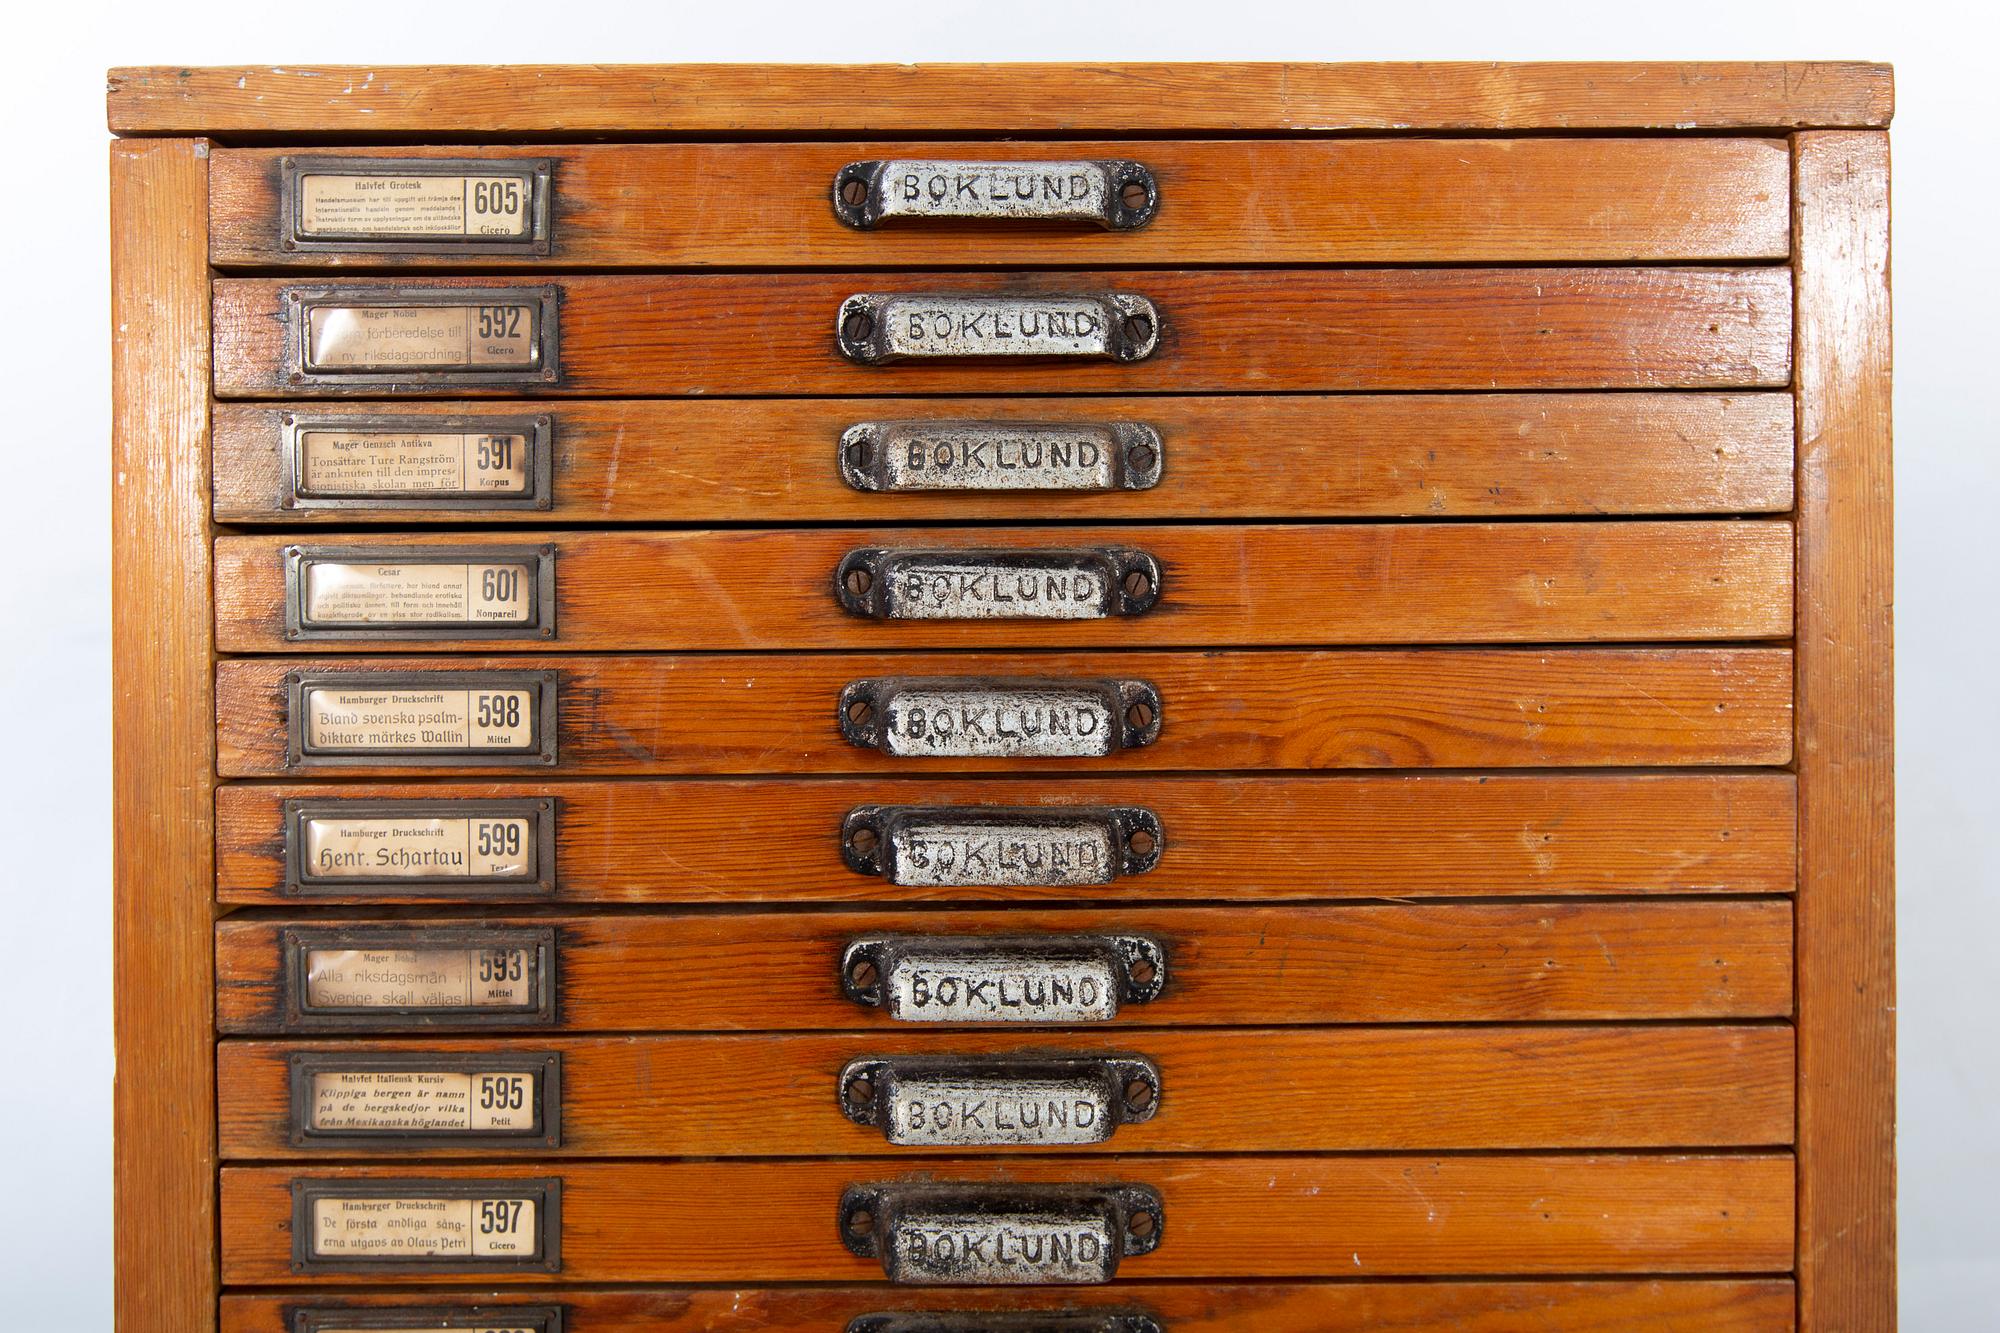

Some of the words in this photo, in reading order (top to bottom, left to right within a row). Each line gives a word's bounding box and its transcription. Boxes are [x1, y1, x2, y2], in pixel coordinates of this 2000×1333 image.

[355, 181, 386, 190] Halvfet
[390, 181, 422, 190] Grotesk
[903, 174, 1091, 204] BOKLUND
[474, 181, 518, 215] 605
[480, 225, 510, 235] Cicero
[361, 310, 388, 319] Mager
[393, 309, 417, 318] Nobel
[479, 307, 521, 339] 592
[908, 312, 1098, 341] BOKLUND
[367, 327, 444, 340] förberedelse
[448, 326, 462, 337] till
[342, 352, 355, 362] ny
[365, 349, 462, 363] riksdagsordning
[487, 346, 514, 355] Cicero
[332, 441, 358, 451] Mager
[363, 440, 397, 449] Genzsch
[400, 439, 433, 448] Antikva
[311, 456, 366, 468] Tonsättare
[369, 455, 395, 465] Ture
[399, 454, 455, 466] Rangström
[477, 437, 512, 471] 591
[907, 441, 1099, 470] BOKLUND
[311, 470, 321, 479] är
[325, 468, 373, 478] anknuten
[376, 467, 391, 477] till
[394, 467, 414, 477] den
[311, 480, 366, 491] sionistiska
[373, 479, 407, 490] skolan
[412, 480, 434, 488] men
[441, 478, 456, 488] för
[480, 478, 510, 488] Korpus
[378, 568, 401, 577] Cesar
[482, 568, 519, 602] 601
[906, 575, 1094, 602] BOKLUND
[476, 608, 518, 619] Nonpareil
[339, 696, 387, 705] Hamburger
[392, 694, 444, 704] Druckschrift
[318, 712, 358, 725] Bland
[362, 712, 415, 725] svenska
[418, 711, 463, 726] psalm-
[478, 695, 519, 728] 598
[906, 708, 1099, 739] BOKLUND
[319, 732, 364, 744] diktare
[369, 730, 416, 744] märkes
[421, 730, 463, 743] Wallin
[487, 735, 511, 744] Mittel
[340, 829, 387, 839] Hamburger
[392, 828, 444, 837] Druckschrift
[478, 823, 520, 856] 599
[320, 848, 370, 871] Henr.
[376, 848, 463, 870] Schartau
[907, 840, 1099, 871] BOKLUND
[363, 954, 389, 963] Mager
[480, 949, 521, 982] 593
[317, 969, 343, 983] Alla
[354, 969, 447, 985] riksdagsmän
[318, 990, 373, 1006] Sverige
[382, 990, 414, 1005] skall
[422, 991, 462, 1006] väljas
[488, 989, 513, 999] Mittel
[911, 976, 1097, 1008] BOKLUND
[341, 1075, 372, 1083] Halvfet
[376, 1075, 413, 1083] Italiensk
[417, 1075, 445, 1083] Kursiv
[320, 1088, 367, 1099] Klippiga
[373, 1089, 411, 1099] bergen
[417, 1089, 429, 1098] är
[435, 1090, 465, 1099] namn
[480, 1077, 523, 1110] 595
[319, 1103, 333, 1114] på
[342, 1103, 355, 1112] de
[364, 1103, 431, 1114] bergskedjor
[438, 1103, 465, 1113] vilka
[909, 1100, 1095, 1131] BOKLUND
[319, 1117, 343, 1126] från
[344, 1118, 409, 1127] Mexikanska
[411, 1117, 465, 1129] höglandet
[491, 1117, 511, 1126] Petit
[342, 1202, 391, 1212] Hamburger
[395, 1201, 446, 1211] Druckschrift
[323, 1217, 337, 1228] De
[346, 1218, 377, 1230] första
[387, 1217, 427, 1230] andliga
[436, 1218, 465, 1231] sång-
[481, 1201, 523, 1234] 597
[323, 1238, 345, 1248] erna
[350, 1237, 387, 1249] utgavs
[391, 1238, 403, 1247] av
[407, 1237, 438, 1248] Olaus
[441, 1237, 466, 1250] Petri
[489, 1242, 515, 1250] Cicero
[907, 1232, 1099, 1264] BOKLUND
